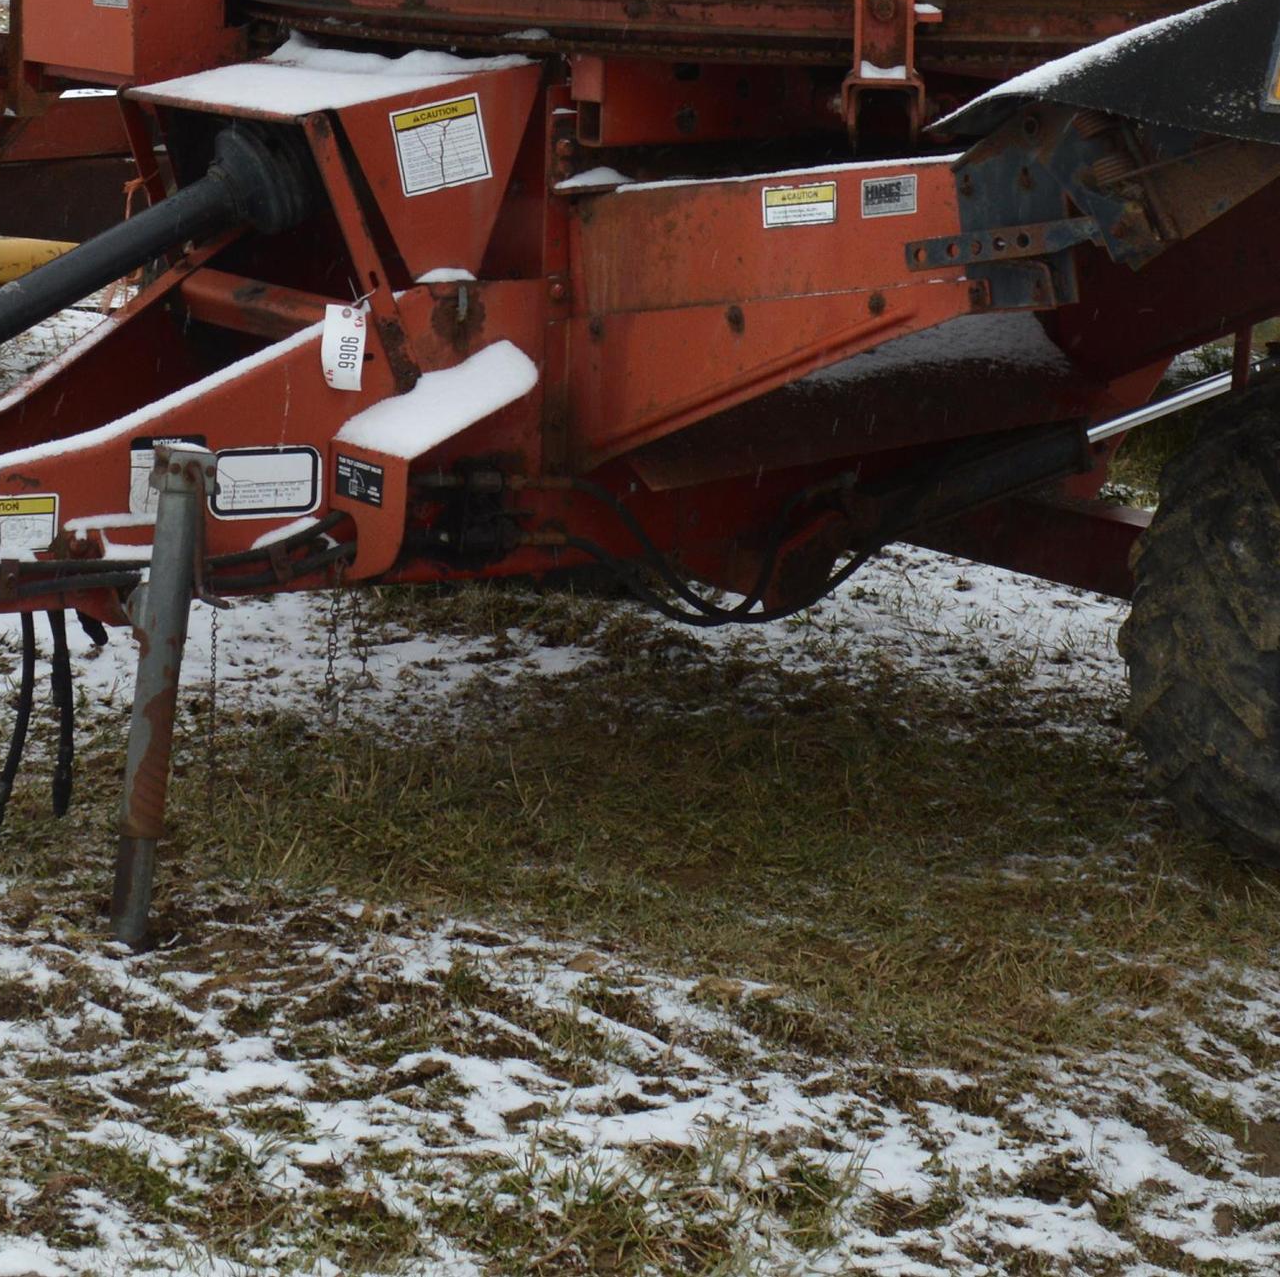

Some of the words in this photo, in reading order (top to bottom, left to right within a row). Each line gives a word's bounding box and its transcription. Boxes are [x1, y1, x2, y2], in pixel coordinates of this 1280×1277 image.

[420, 106, 458, 120] CAUTION
[787, 190, 818, 200] CAUTION
[152, 438, 182, 447] NOTICE
